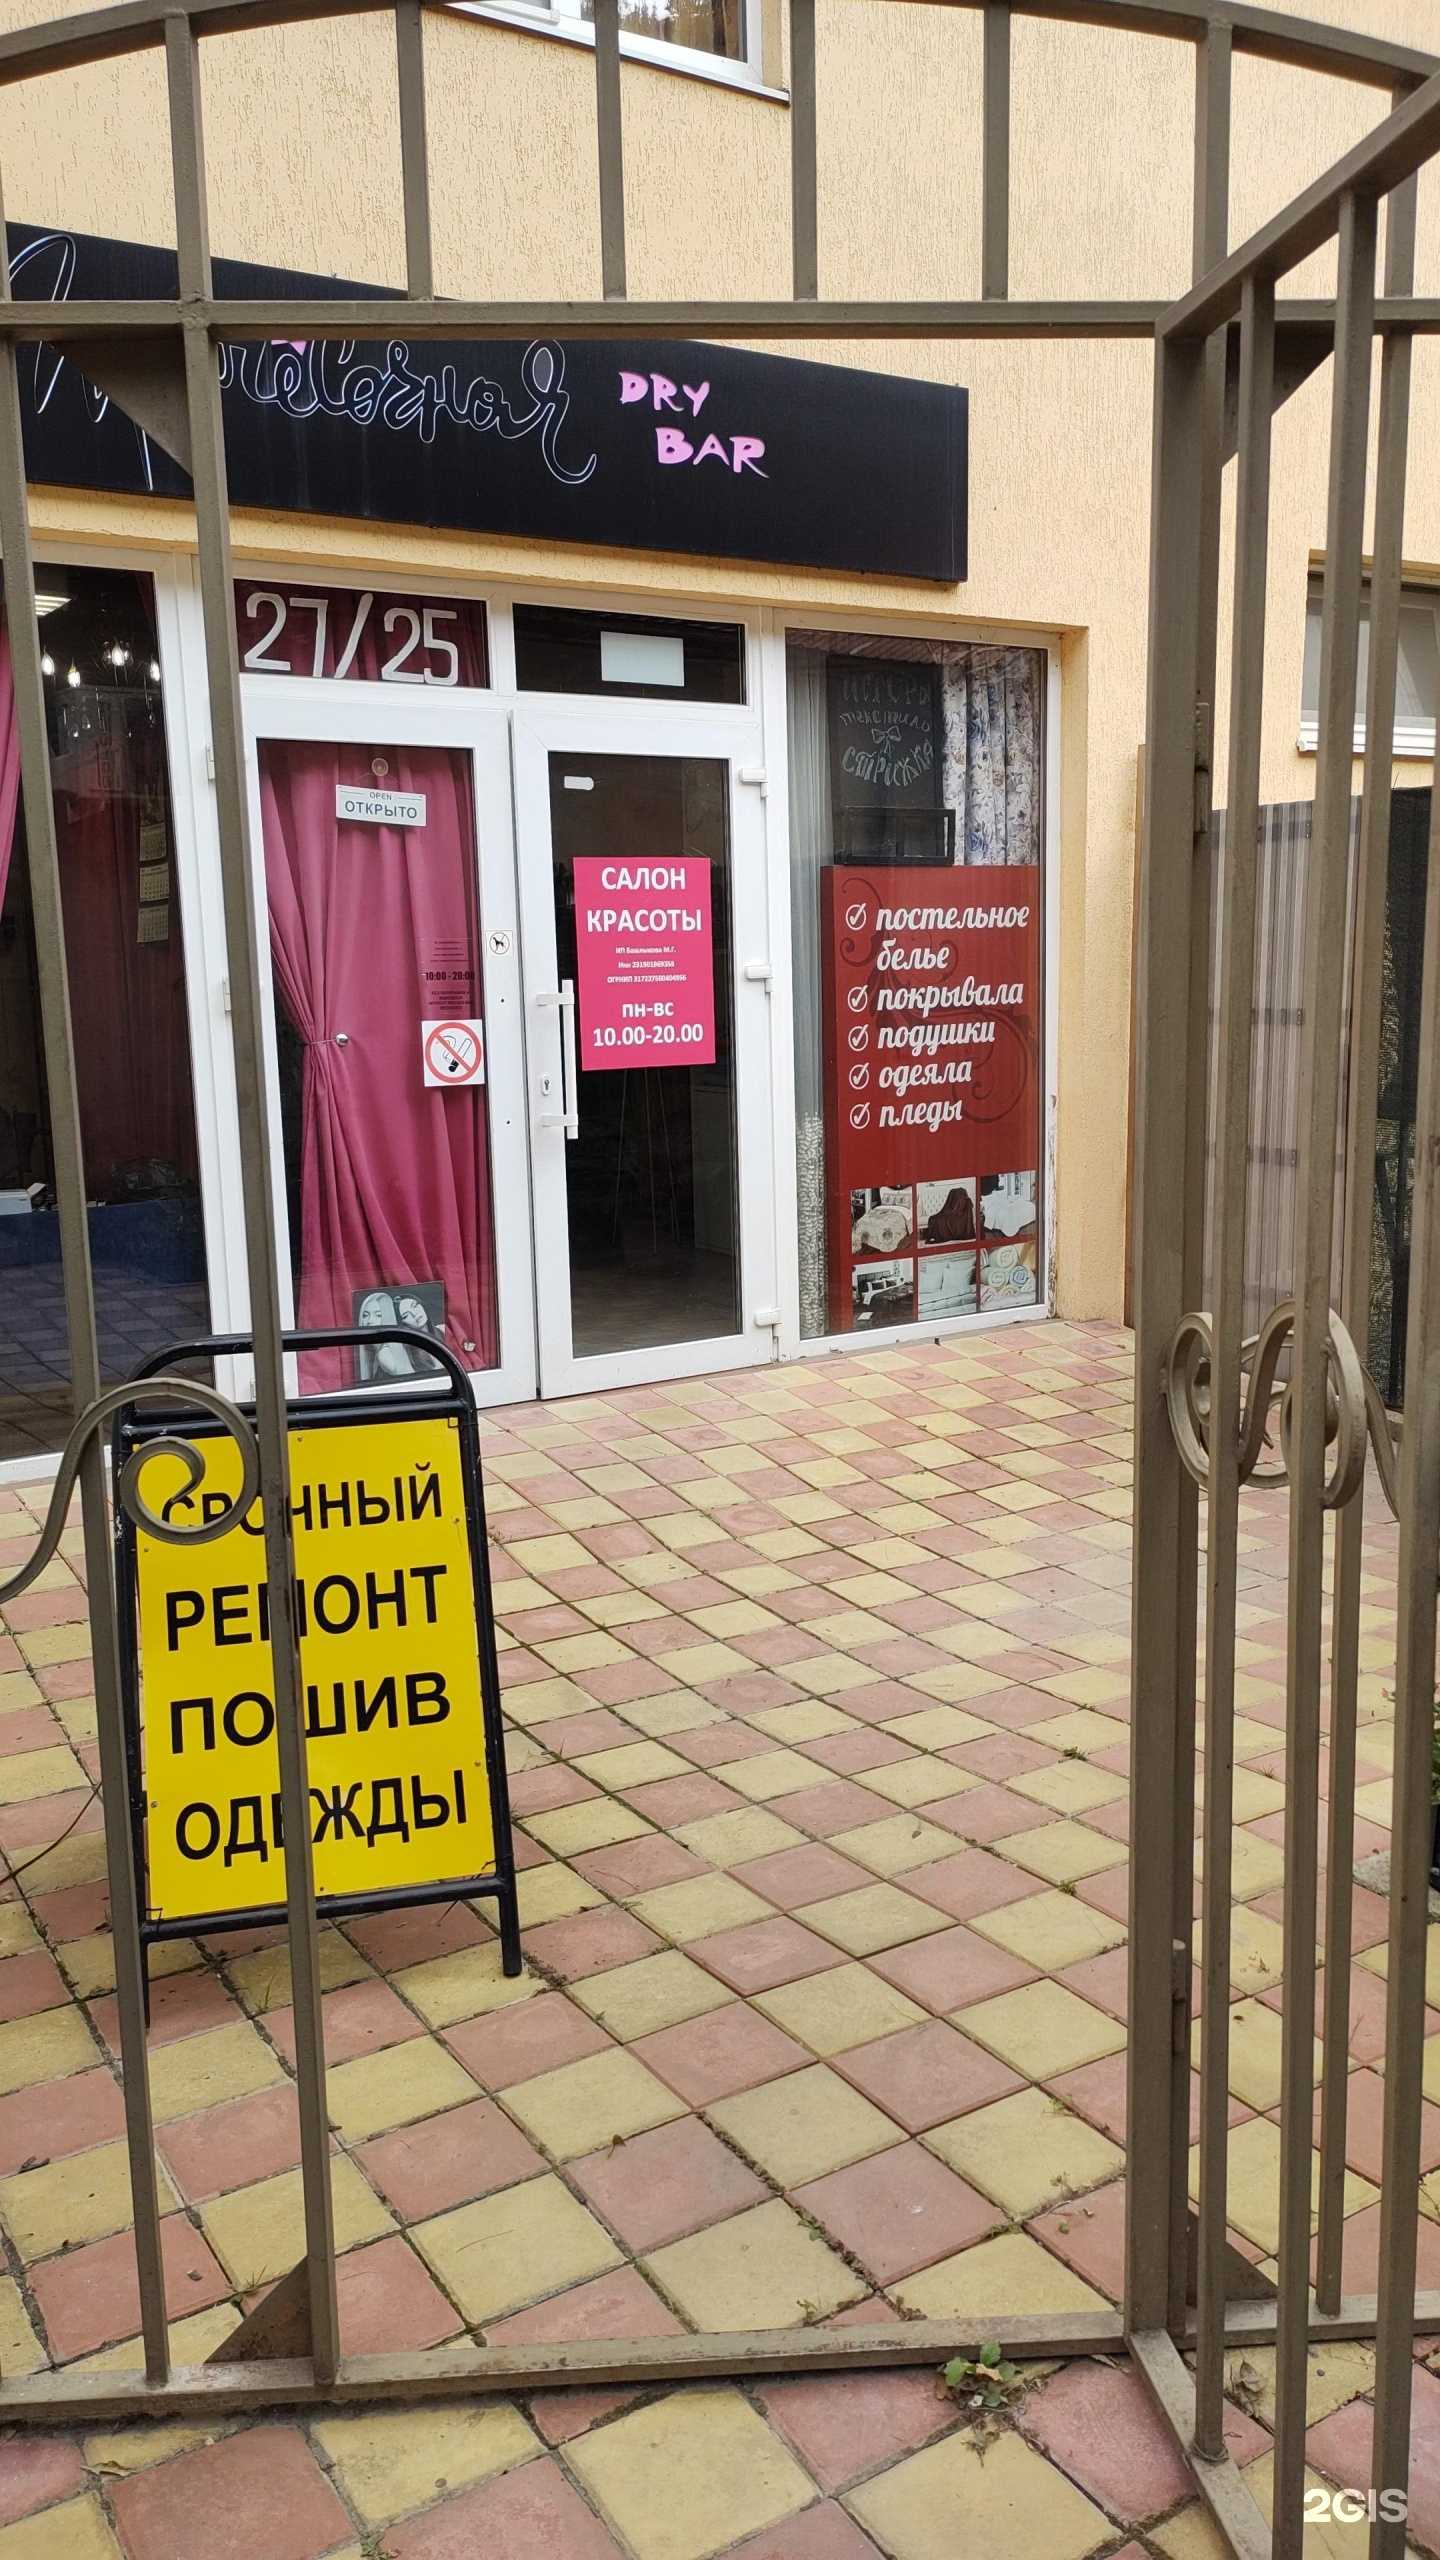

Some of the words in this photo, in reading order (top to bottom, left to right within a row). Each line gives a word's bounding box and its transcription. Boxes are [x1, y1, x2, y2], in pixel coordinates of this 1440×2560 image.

[618, 371, 711, 417] DRY
[655, 427, 770, 479] BAR
[244, 592, 459, 686] 27/25
[345, 800, 417, 819] ОТКРЫТО
[369, 791, 392, 800] OPEN
[601, 866, 686, 890] САЛОН
[586, 908, 702, 933] КРАСОТЫ
[875, 905, 1030, 931] постельное
[876, 938, 950, 971] белье
[877, 976, 1024, 1018] покрывала
[592, 1023, 704, 1047] 10.00-20.00
[877, 1021, 996, 1056] подушки
[878, 1060, 973, 1096] одеяла
[879, 1099, 963, 1132] пледы
[169, 1671, 452, 1755] ПОШИВ
